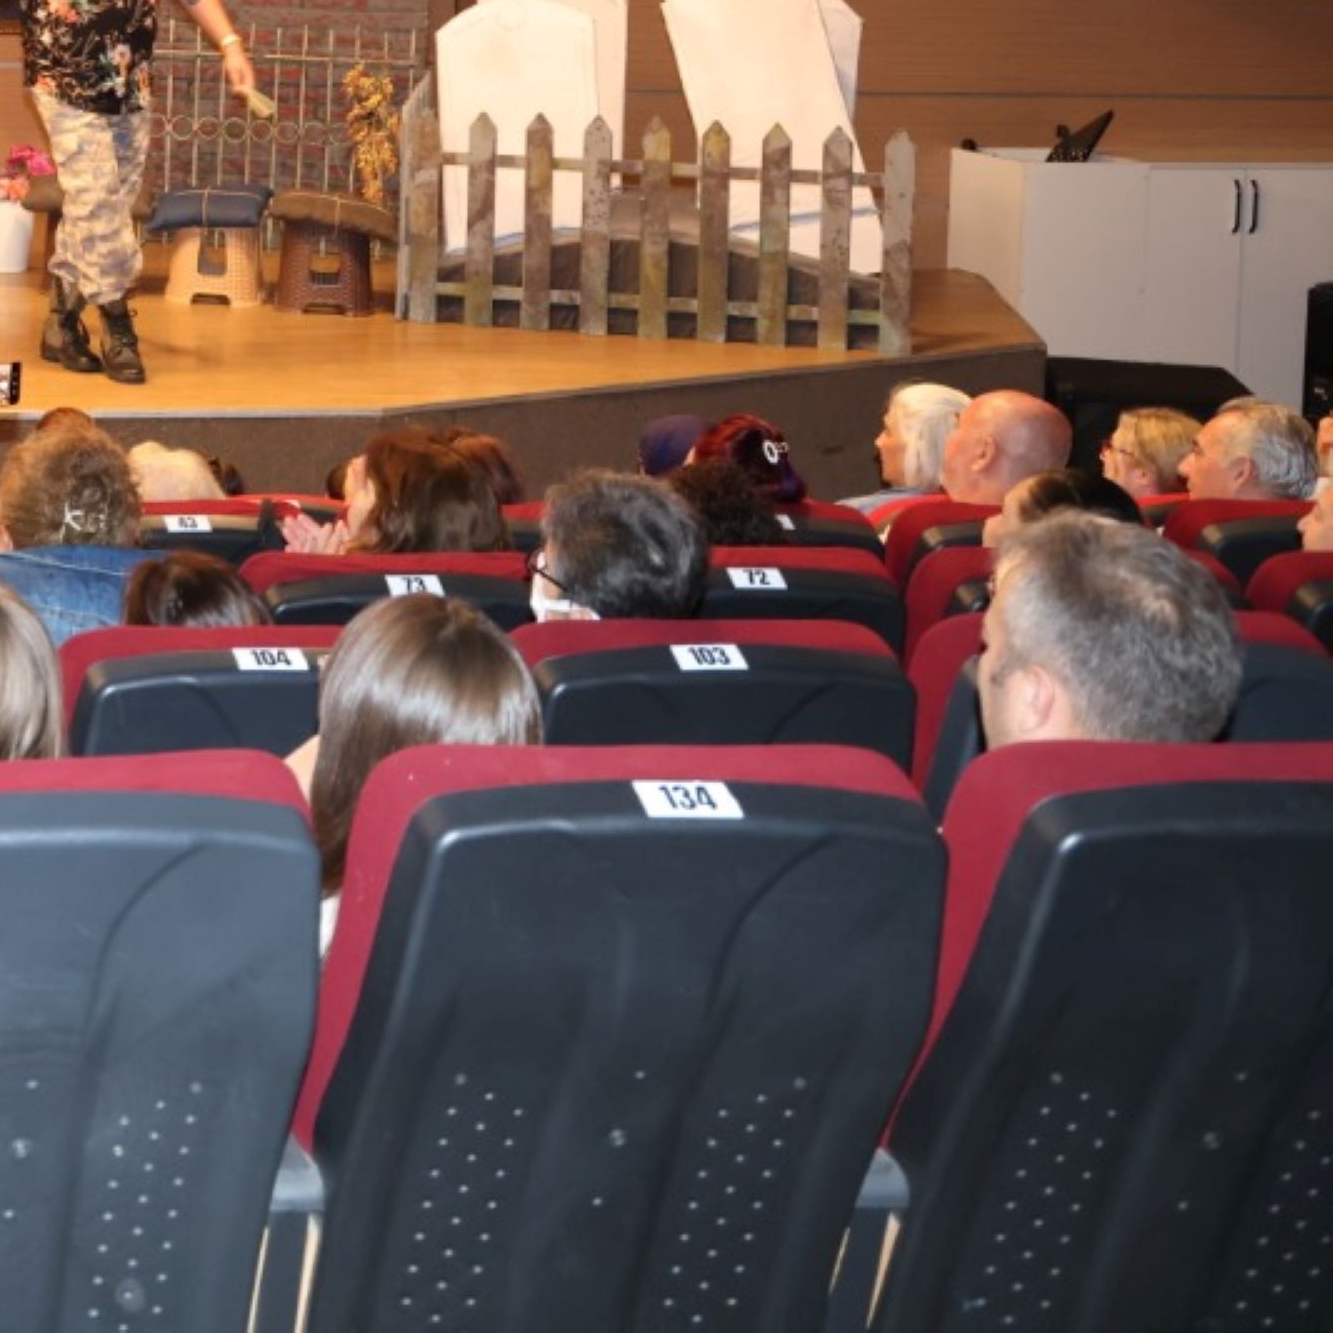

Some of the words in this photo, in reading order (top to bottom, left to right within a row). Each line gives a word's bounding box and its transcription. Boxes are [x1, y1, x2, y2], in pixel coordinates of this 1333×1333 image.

[402, 576, 427, 593] 73
[742, 569, 771, 585] 72
[249, 649, 293, 666] 104
[687, 646, 732, 665] 103
[657, 784, 718, 811] 134
